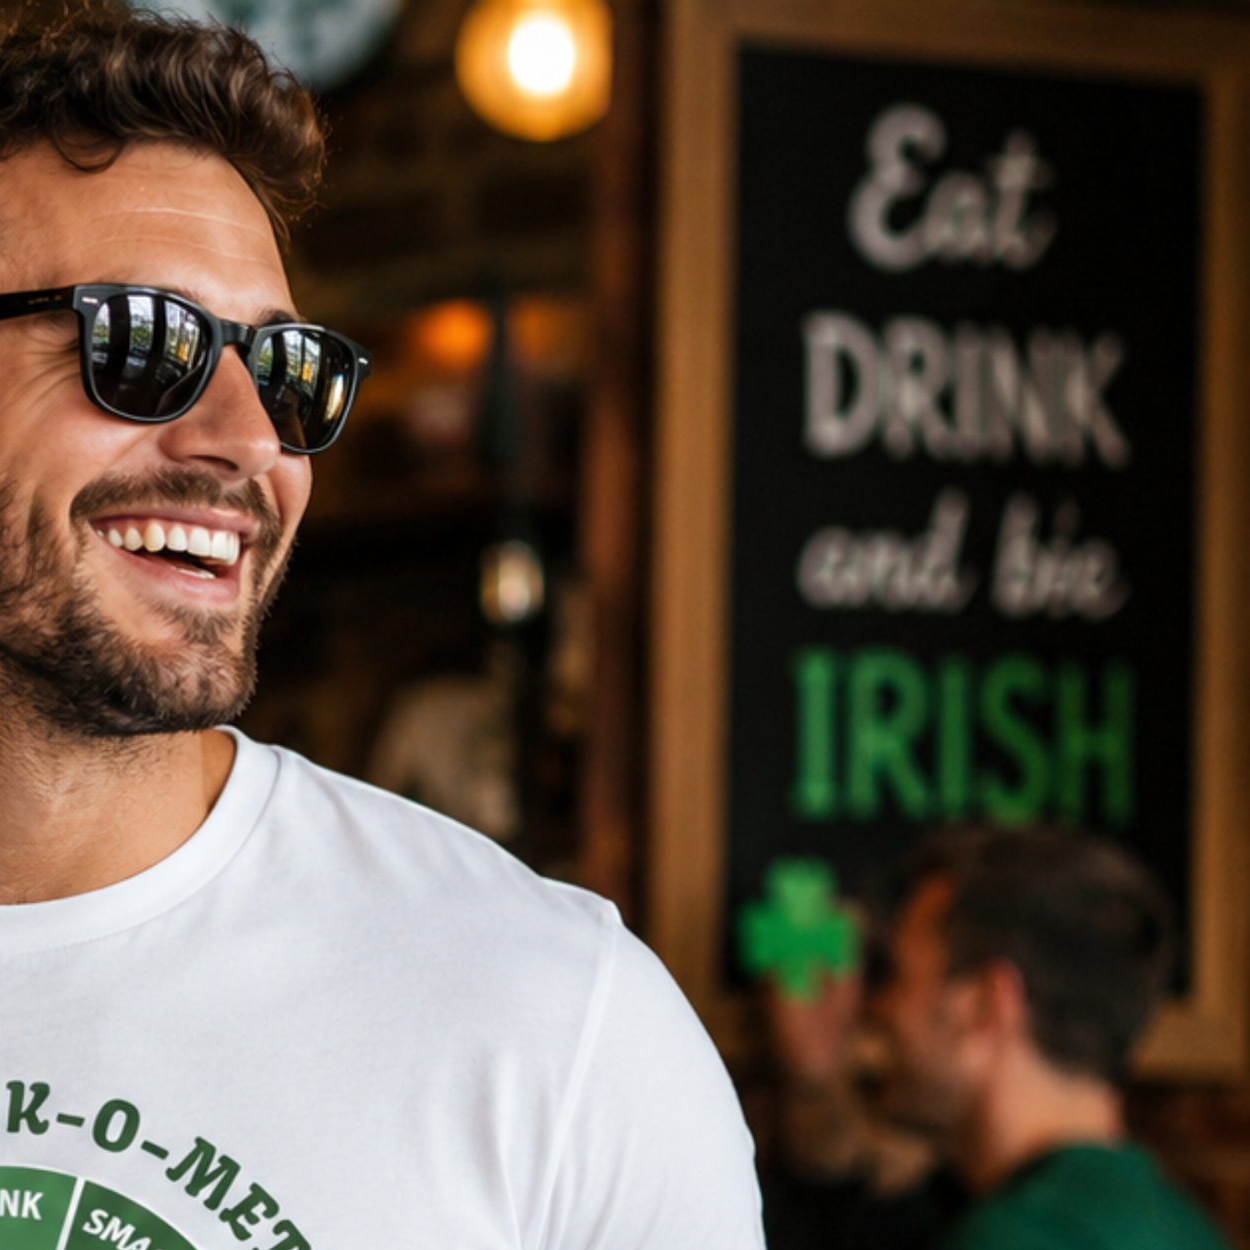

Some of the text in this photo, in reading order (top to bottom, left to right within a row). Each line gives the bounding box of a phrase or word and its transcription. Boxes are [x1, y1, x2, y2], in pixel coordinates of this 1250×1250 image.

[849, 105, 1054, 270] Eat
[803, 311, 1128, 467] DRINK
[799, 487, 976, 612] and
[794, 647, 1135, 825] IRISH
